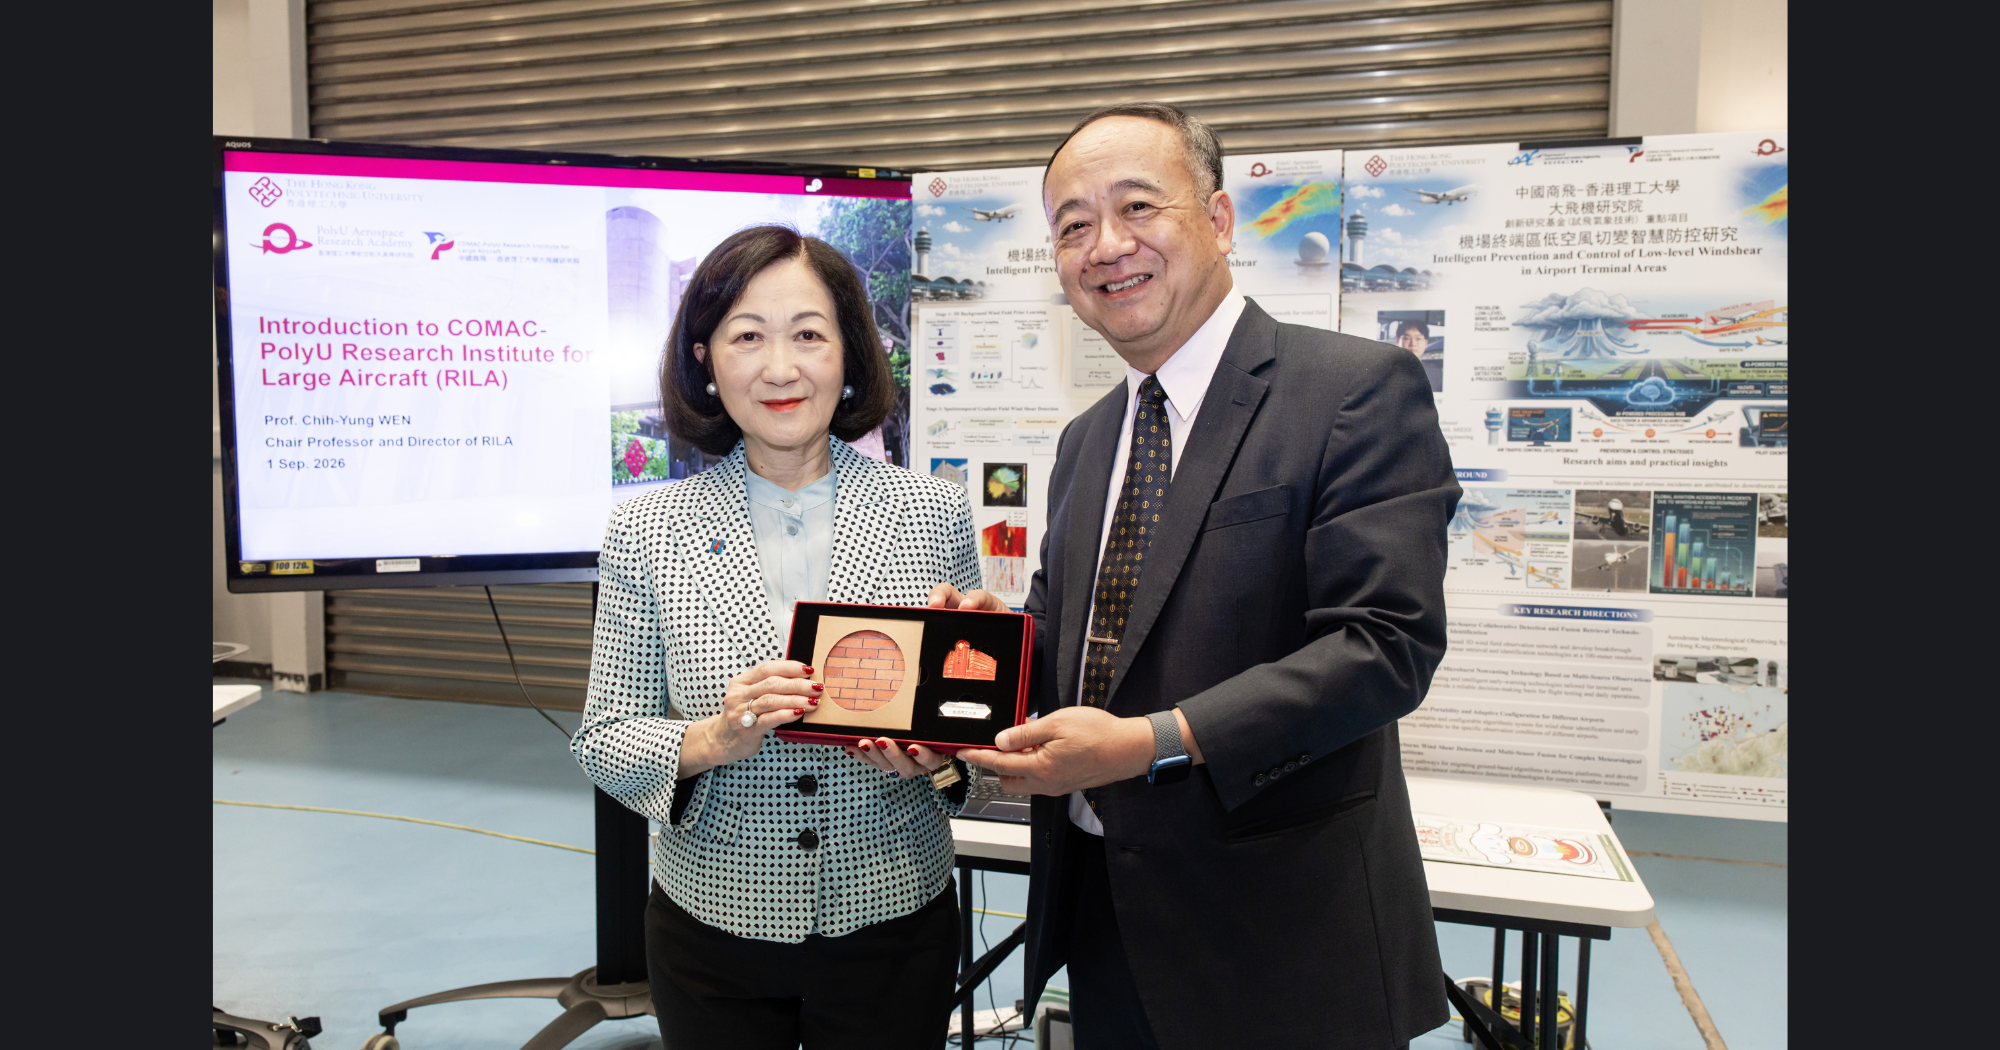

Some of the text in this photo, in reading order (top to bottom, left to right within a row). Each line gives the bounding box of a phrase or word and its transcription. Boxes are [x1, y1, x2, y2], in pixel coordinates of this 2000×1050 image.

[1389, 154, 1404, 162] THE
[1389, 158, 1487, 168] POLYTECHNIC UNIVERSITY
[285, 179, 377, 191] THE HONG KONG
[285, 188, 425, 202] POLYTECHNIC UNIVERSITY
[285, 200, 347, 209] 香港理工大學
[1549, 198, 1644, 215] 大飛機研究院
[1645, 213, 1688, 224] 重點項目
[316, 225, 405, 239] PolyU Aerospace
[1458, 226, 1738, 250] 機場終端區低空風切變智慧防控研究
[317, 236, 414, 249] Research Academy
[1432, 246, 1763, 264] Intelligent Prevention and Control of Low-level Windshear
[986, 266, 1031, 276] Intelligent
[1521, 263, 1668, 277] in Airport Terminal Areas
[259, 316, 547, 338] Introduction to COMAC-
[260, 342, 593, 365] PolyU Research Institute for
[262, 368, 508, 391] Large Aircraft (RILA)
[264, 414, 412, 428] Prof. Chih-Yung WEN
[265, 435, 514, 448] Chair Professor and Director of RILA
[266, 458, 346, 472] 1 Sep. 2026
[1563, 457, 1728, 470] Research aims and practical insights
[1513, 606, 1639, 619] KEY RESEARCH DIRECTIONS
[1478, 622, 1518, 630] Collaborative
[1677, 642, 1693, 650] Hong
[1694, 643, 1711, 651] Kong
[1712, 644, 1748, 653] Observatory
[1701, 636, 1745, 644] Meteorological
[1746, 638, 1777, 646] Observing
[1443, 665, 1475, 673] Microburst
[1476, 667, 1509, 676] Nowcasting
[1510, 669, 1542, 678] Technology
[1612, 675, 1652, 683] Observations
[1430, 706, 1460, 714] Portability
[1473, 709, 1498, 717] Adaptive
[1500, 711, 1540, 719] Configuration
[1580, 716, 1605, 724] Airports
[1456, 745, 1483, 753] Detection
[1498, 749, 1535, 757] Multi-Sensor
[1569, 754, 1596, 762] Complex
[1597, 756, 1642, 765] Meteorological
